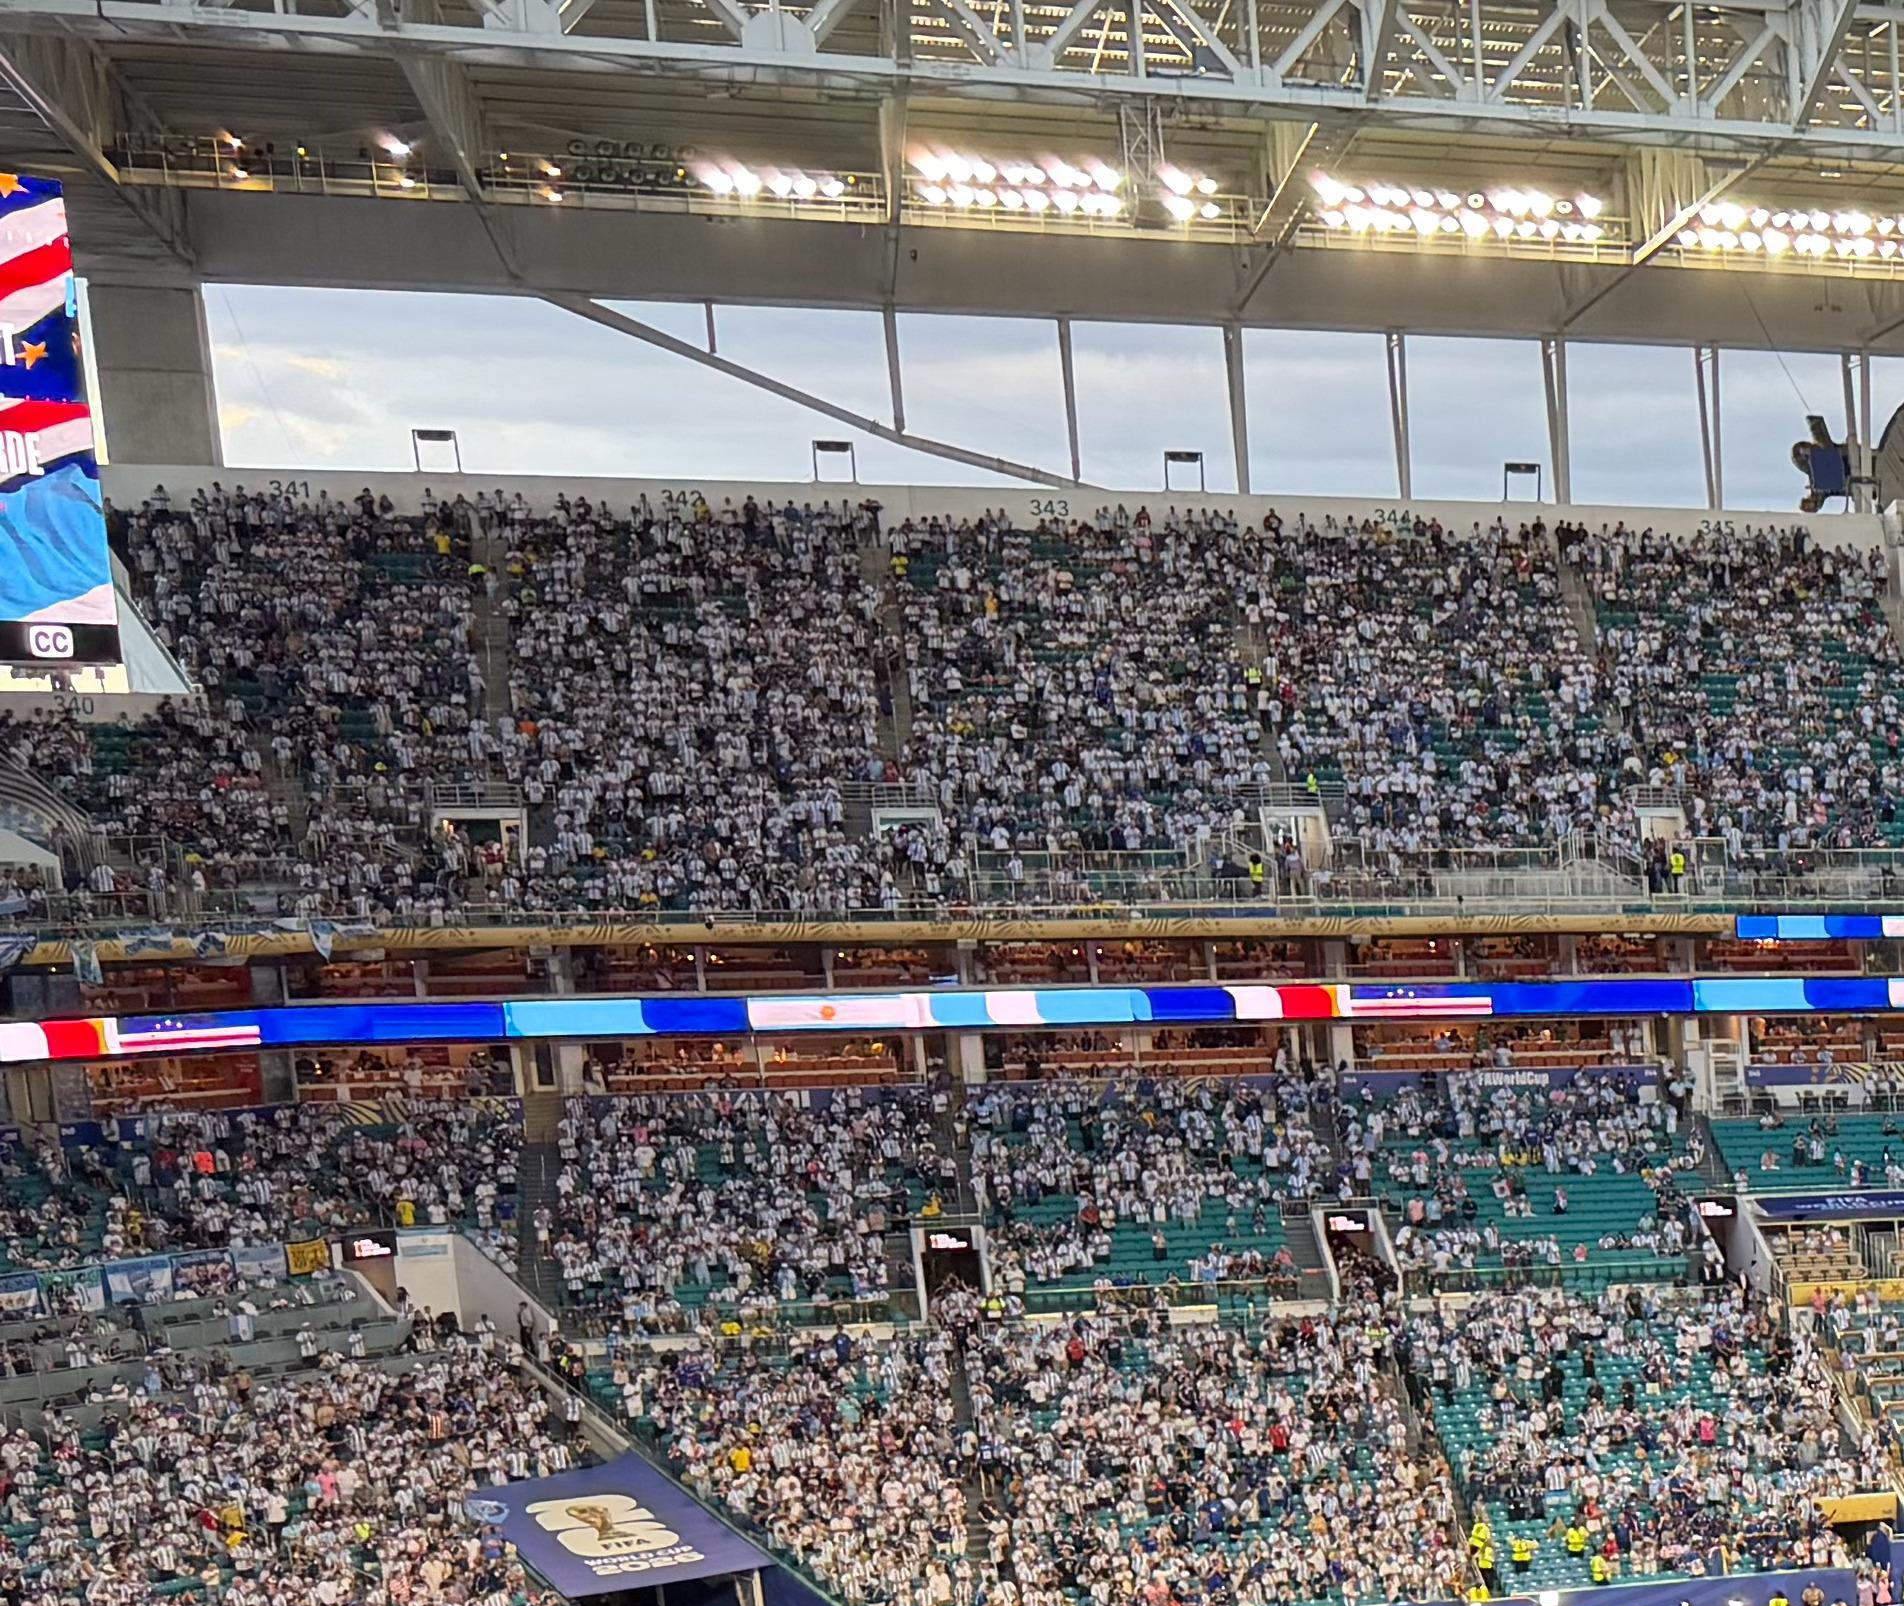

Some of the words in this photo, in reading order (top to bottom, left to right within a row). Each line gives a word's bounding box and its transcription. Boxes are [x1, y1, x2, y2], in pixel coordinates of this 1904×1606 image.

[269, 480, 310, 498] 341
[661, 489, 702, 508] 342
[1030, 499, 1069, 516] 343
[1374, 509, 1411, 525] 344
[1701, 520, 1735, 537] 345
[34, 630, 69, 654] CC
[600, 1537, 652, 1550] FIFA
[584, 1552, 648, 1567] WORLD
[592, 1551, 705, 1576] 2026
